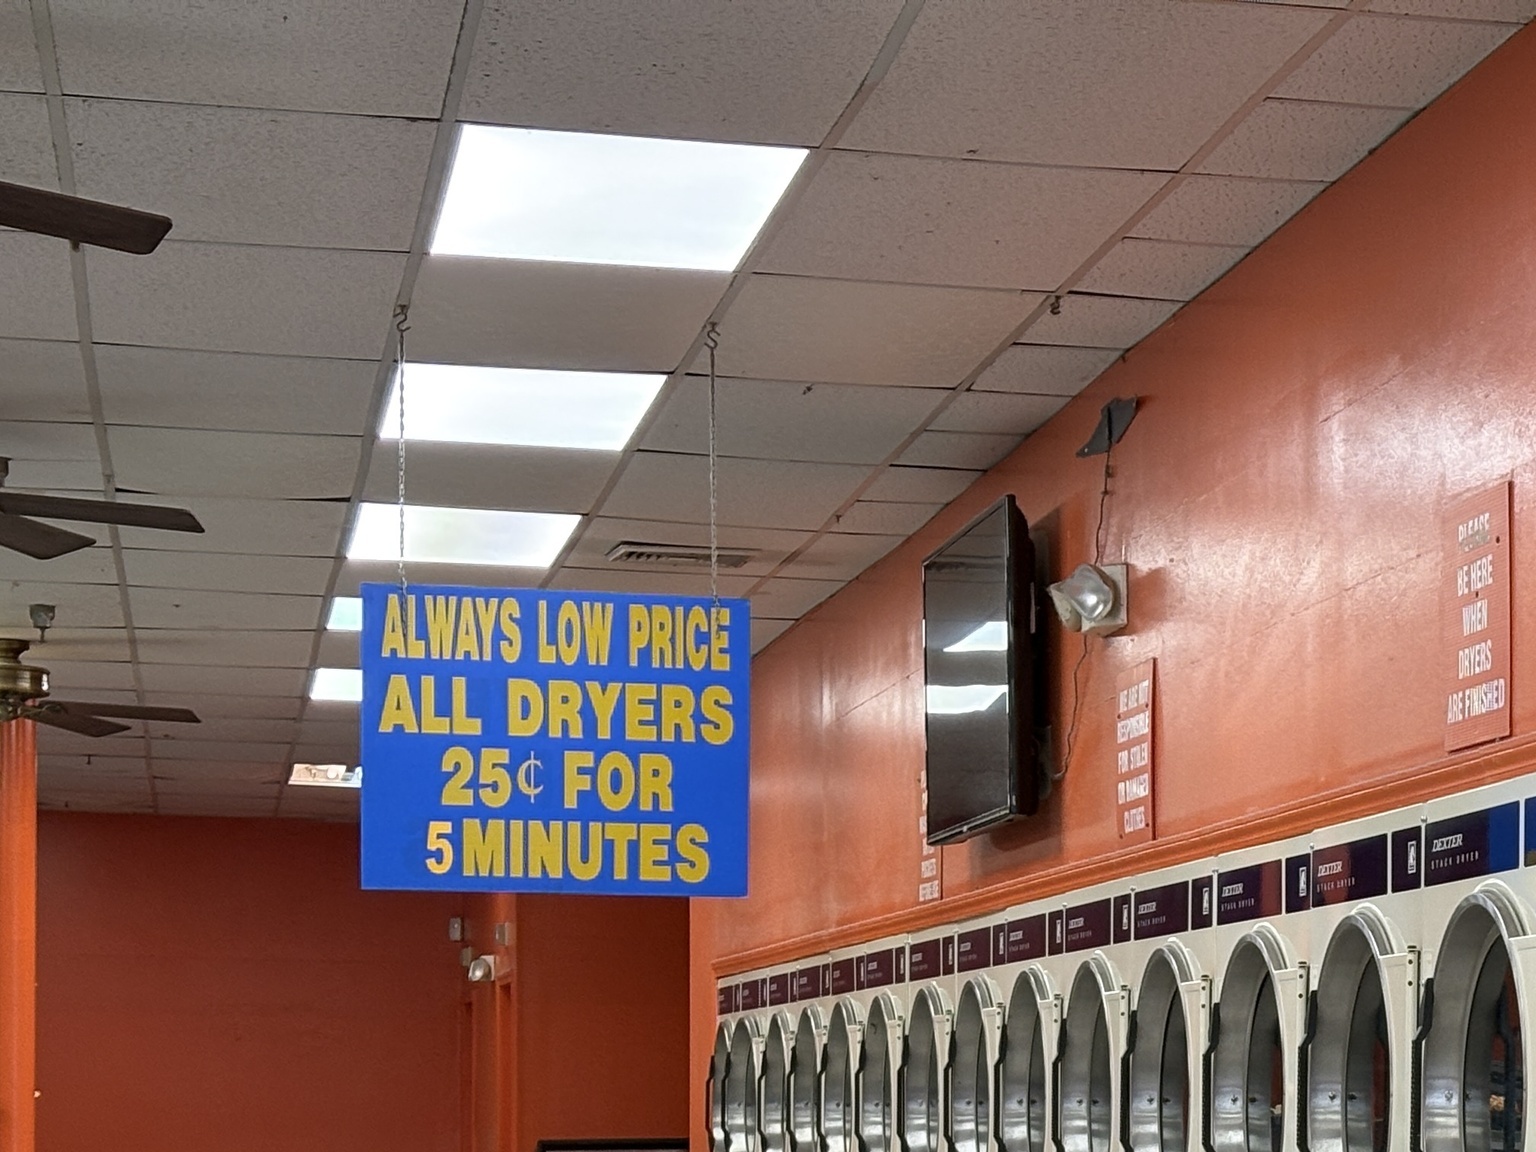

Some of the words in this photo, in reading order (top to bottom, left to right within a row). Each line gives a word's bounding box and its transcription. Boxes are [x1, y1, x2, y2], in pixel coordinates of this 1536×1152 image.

[1457, 566, 1469, 598] BE
[1471, 554, 1494, 592] HERE
[381, 593, 522, 663] ALWAYS
[538, 600, 614, 666] LOW
[628, 604, 731, 671] PRICE
[1463, 598, 1488, 637] WHEN
[1458, 639, 1492, 680] DRYERS
[378, 674, 482, 735] ALL
[507, 678, 734, 745] DRYERS
[1447, 691, 1463, 725] ARE
[1465, 678, 1505, 720] FINISHED
[441, 746, 544, 808] 25¢
[563, 750, 674, 812] FOR
[426, 821, 453, 874] 5
[462, 818, 710, 883] MINUTES
[1431, 833, 1463, 852] DEXTER
